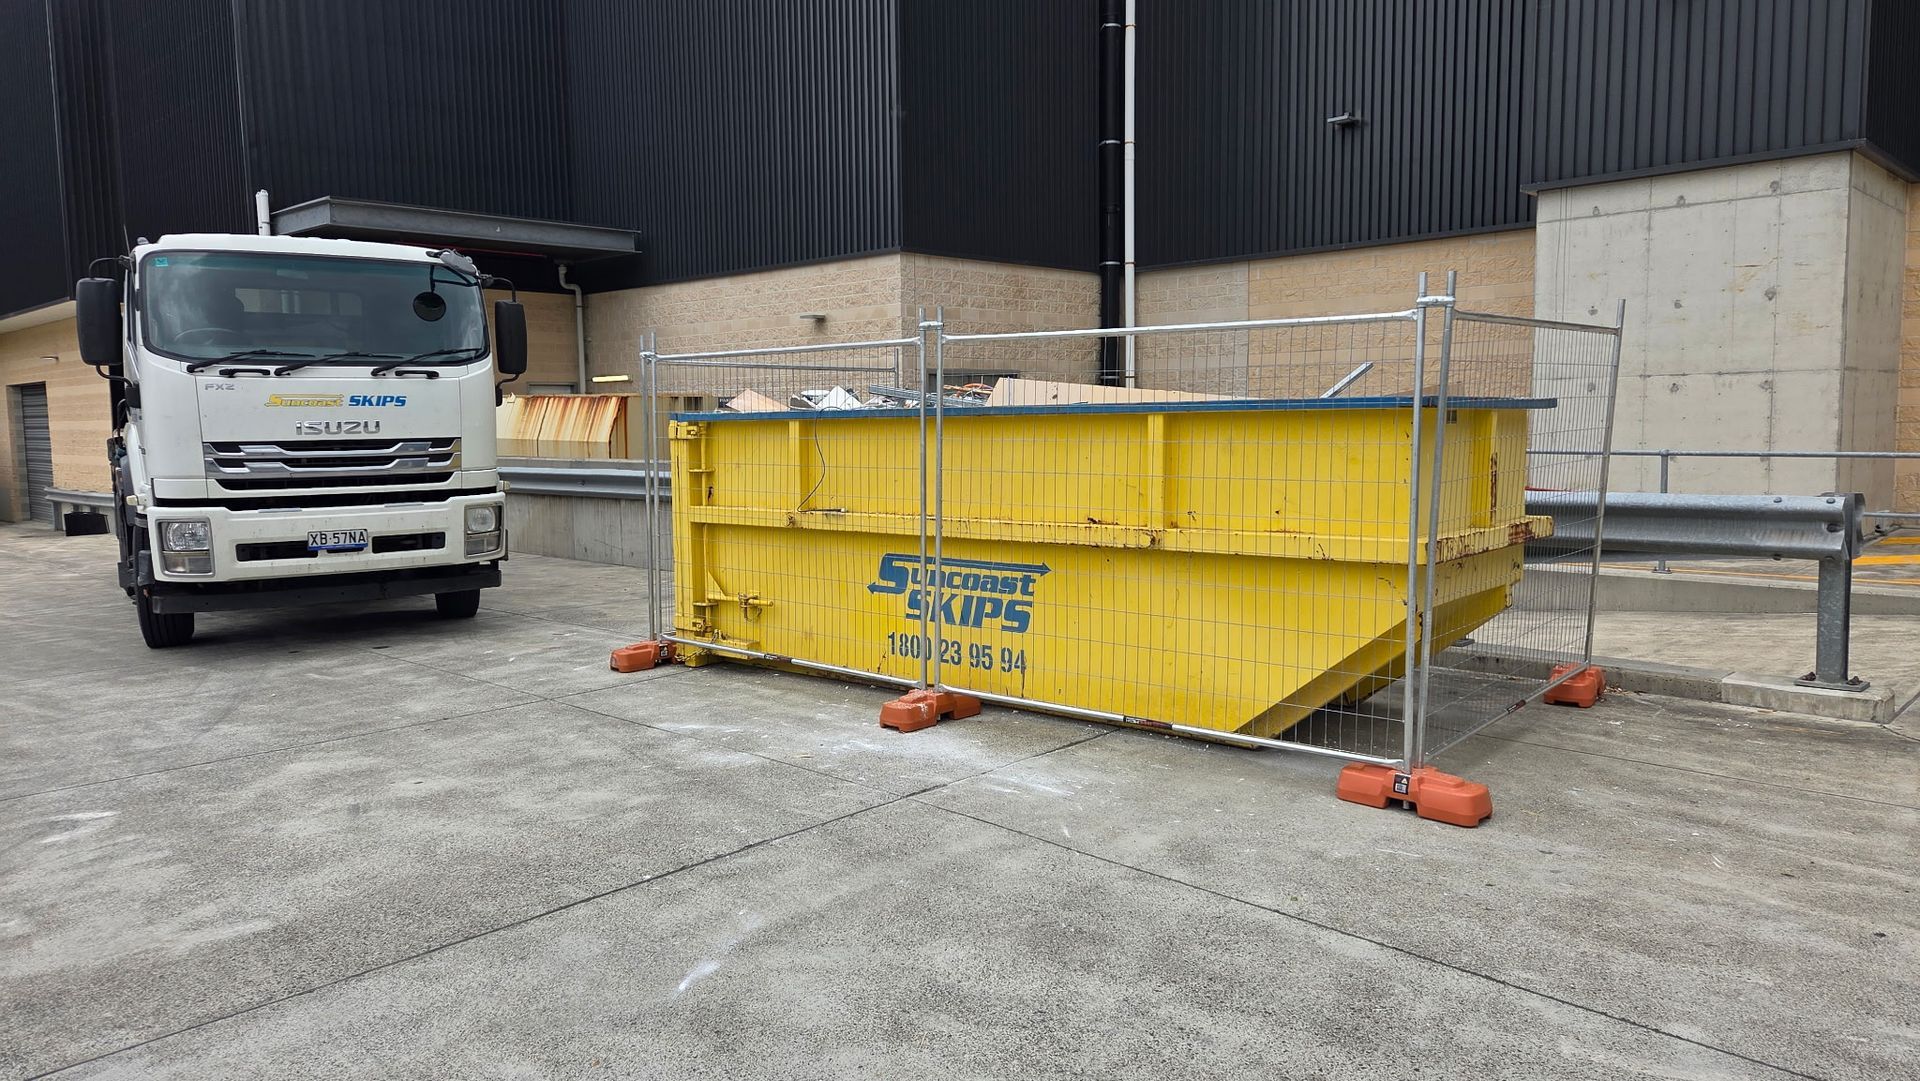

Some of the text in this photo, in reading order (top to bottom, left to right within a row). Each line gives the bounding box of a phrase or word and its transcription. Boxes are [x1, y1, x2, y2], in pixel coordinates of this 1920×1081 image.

[265, 393, 407, 408] Suncoast SKIPS
[295, 420, 381, 436] ISUZU
[867, 553, 1046, 596] Suncoast
[906, 589, 1033, 633] SKIPS
[939, 639, 962, 665] 23
[969, 643, 993, 670] 95
[1000, 647, 1026, 674] 94
